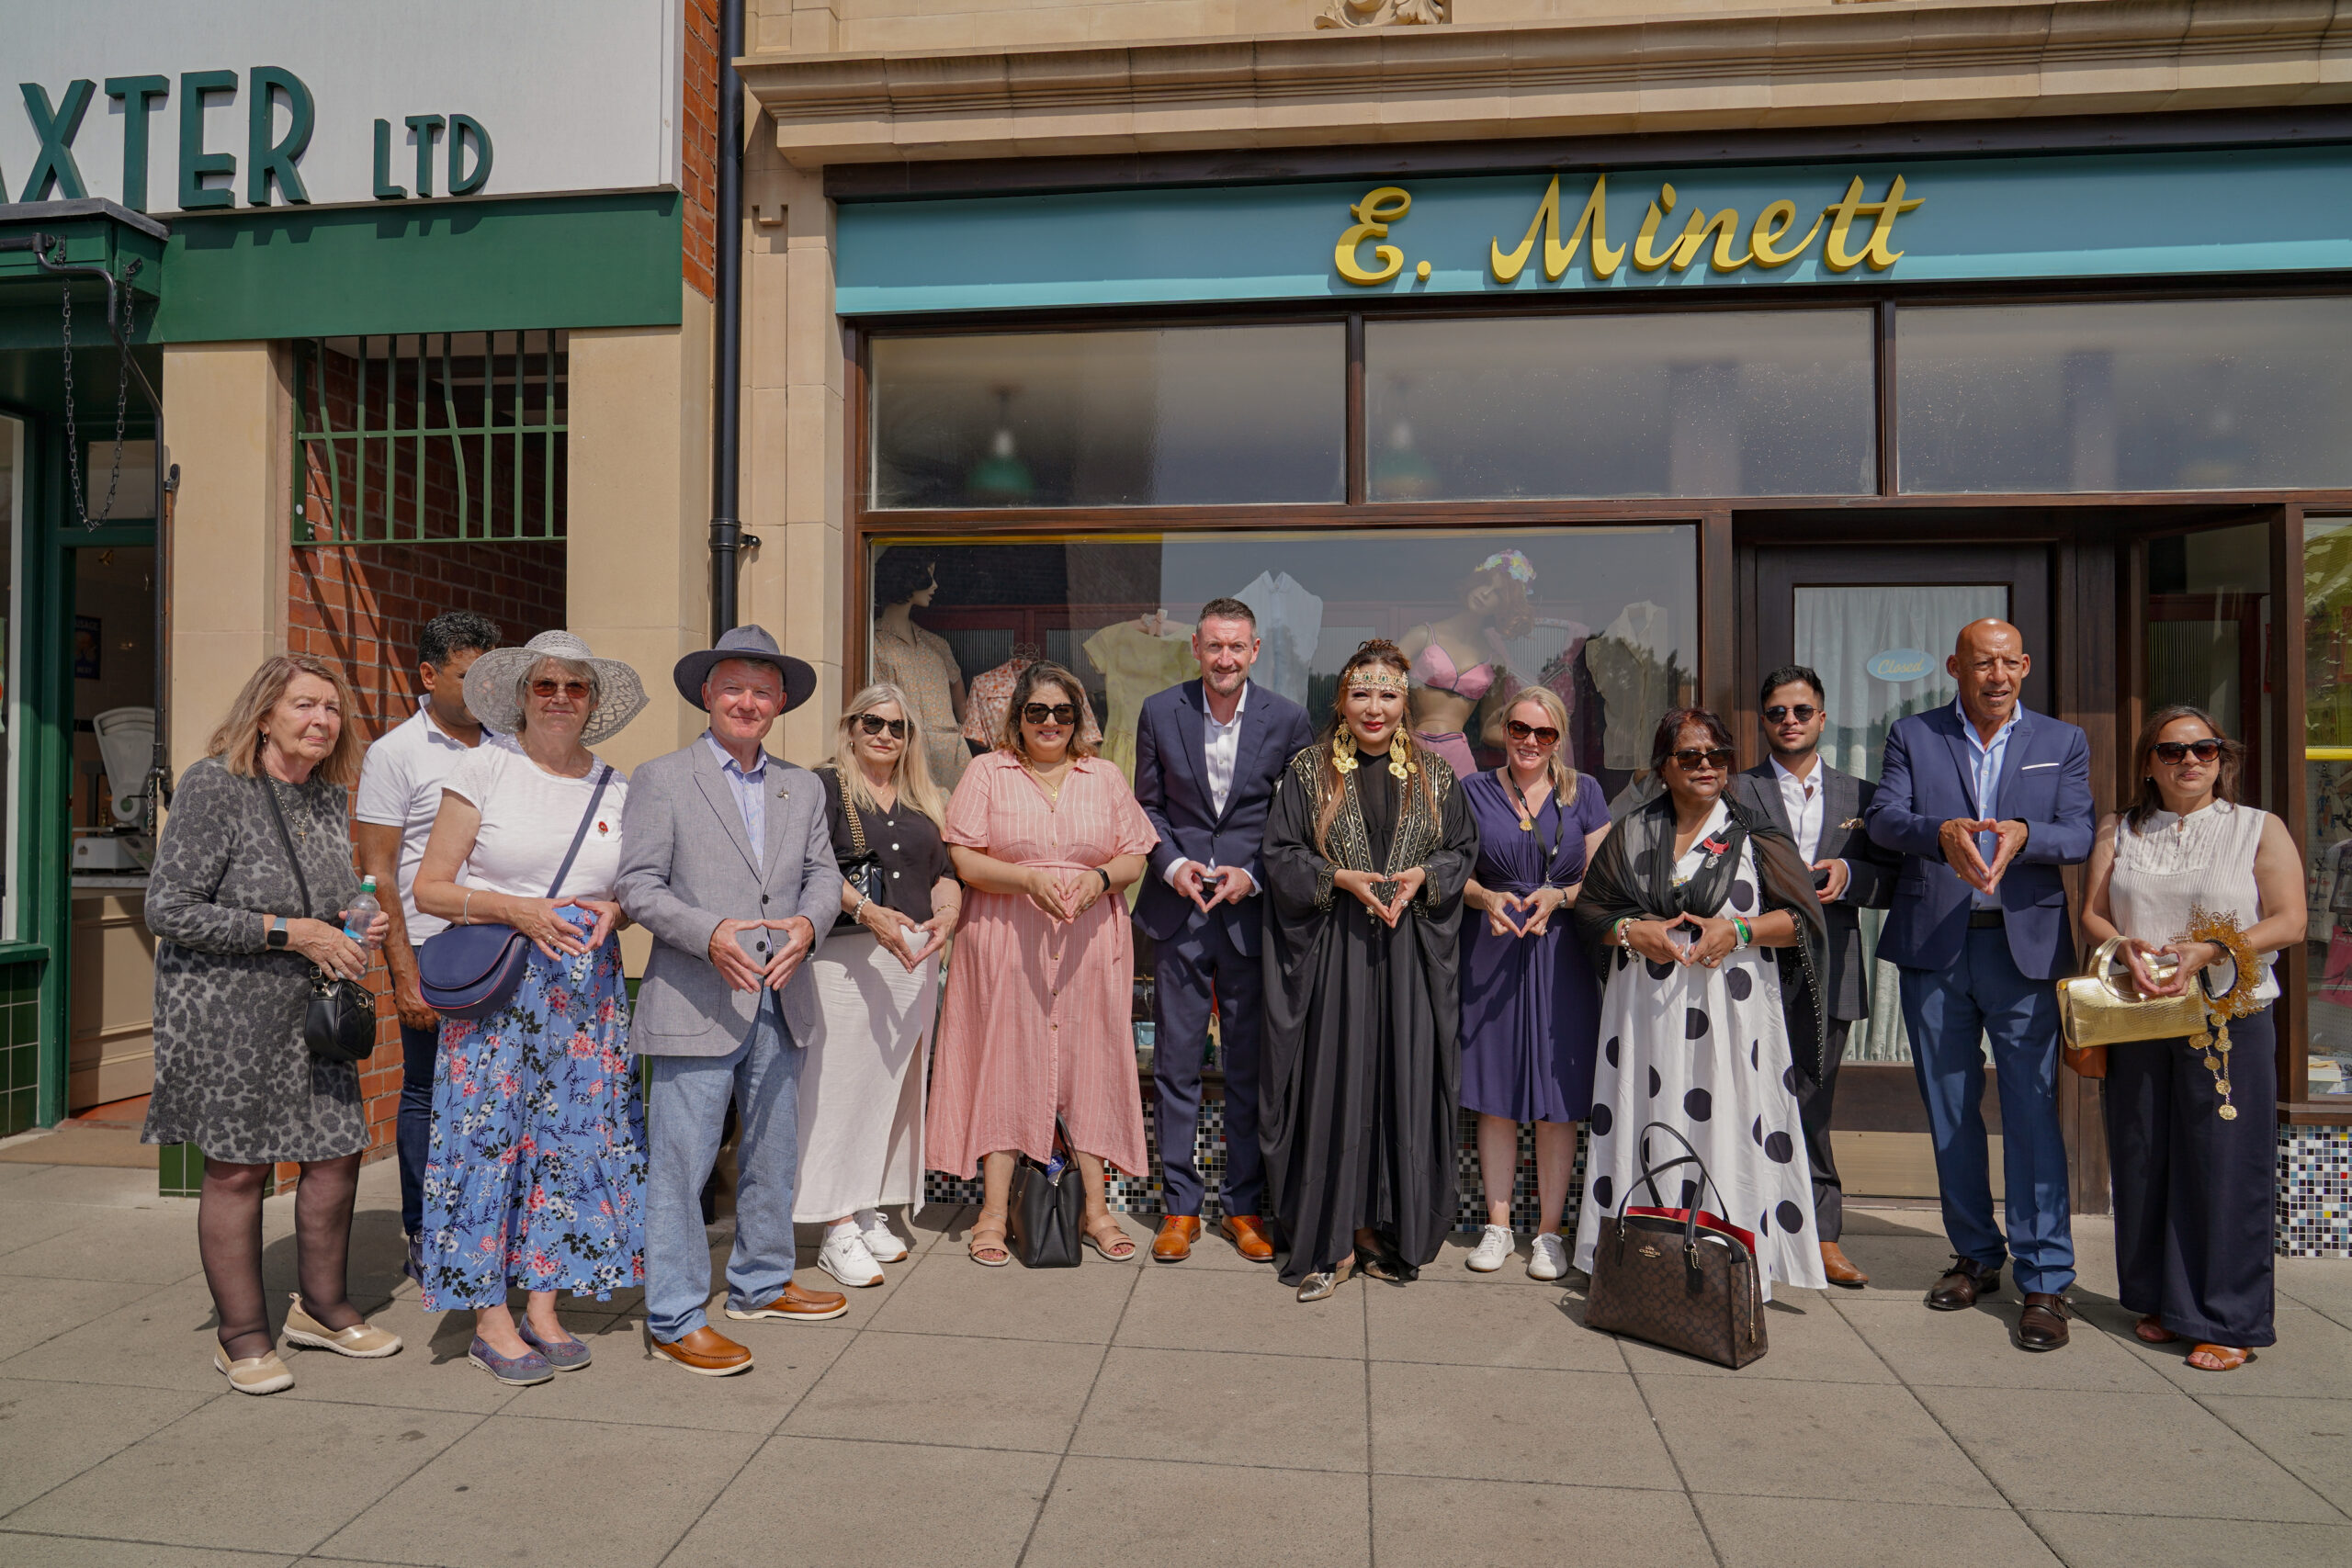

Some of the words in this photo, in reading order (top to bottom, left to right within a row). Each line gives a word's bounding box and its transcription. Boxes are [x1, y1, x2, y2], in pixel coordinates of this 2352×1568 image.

[0, 65, 314, 213] XTER
[374, 114, 493, 200] LTD
[1335, 187, 1431, 286] E.
[1491, 174, 1927, 284] Minett
[1877, 658, 1925, 674] Closed
